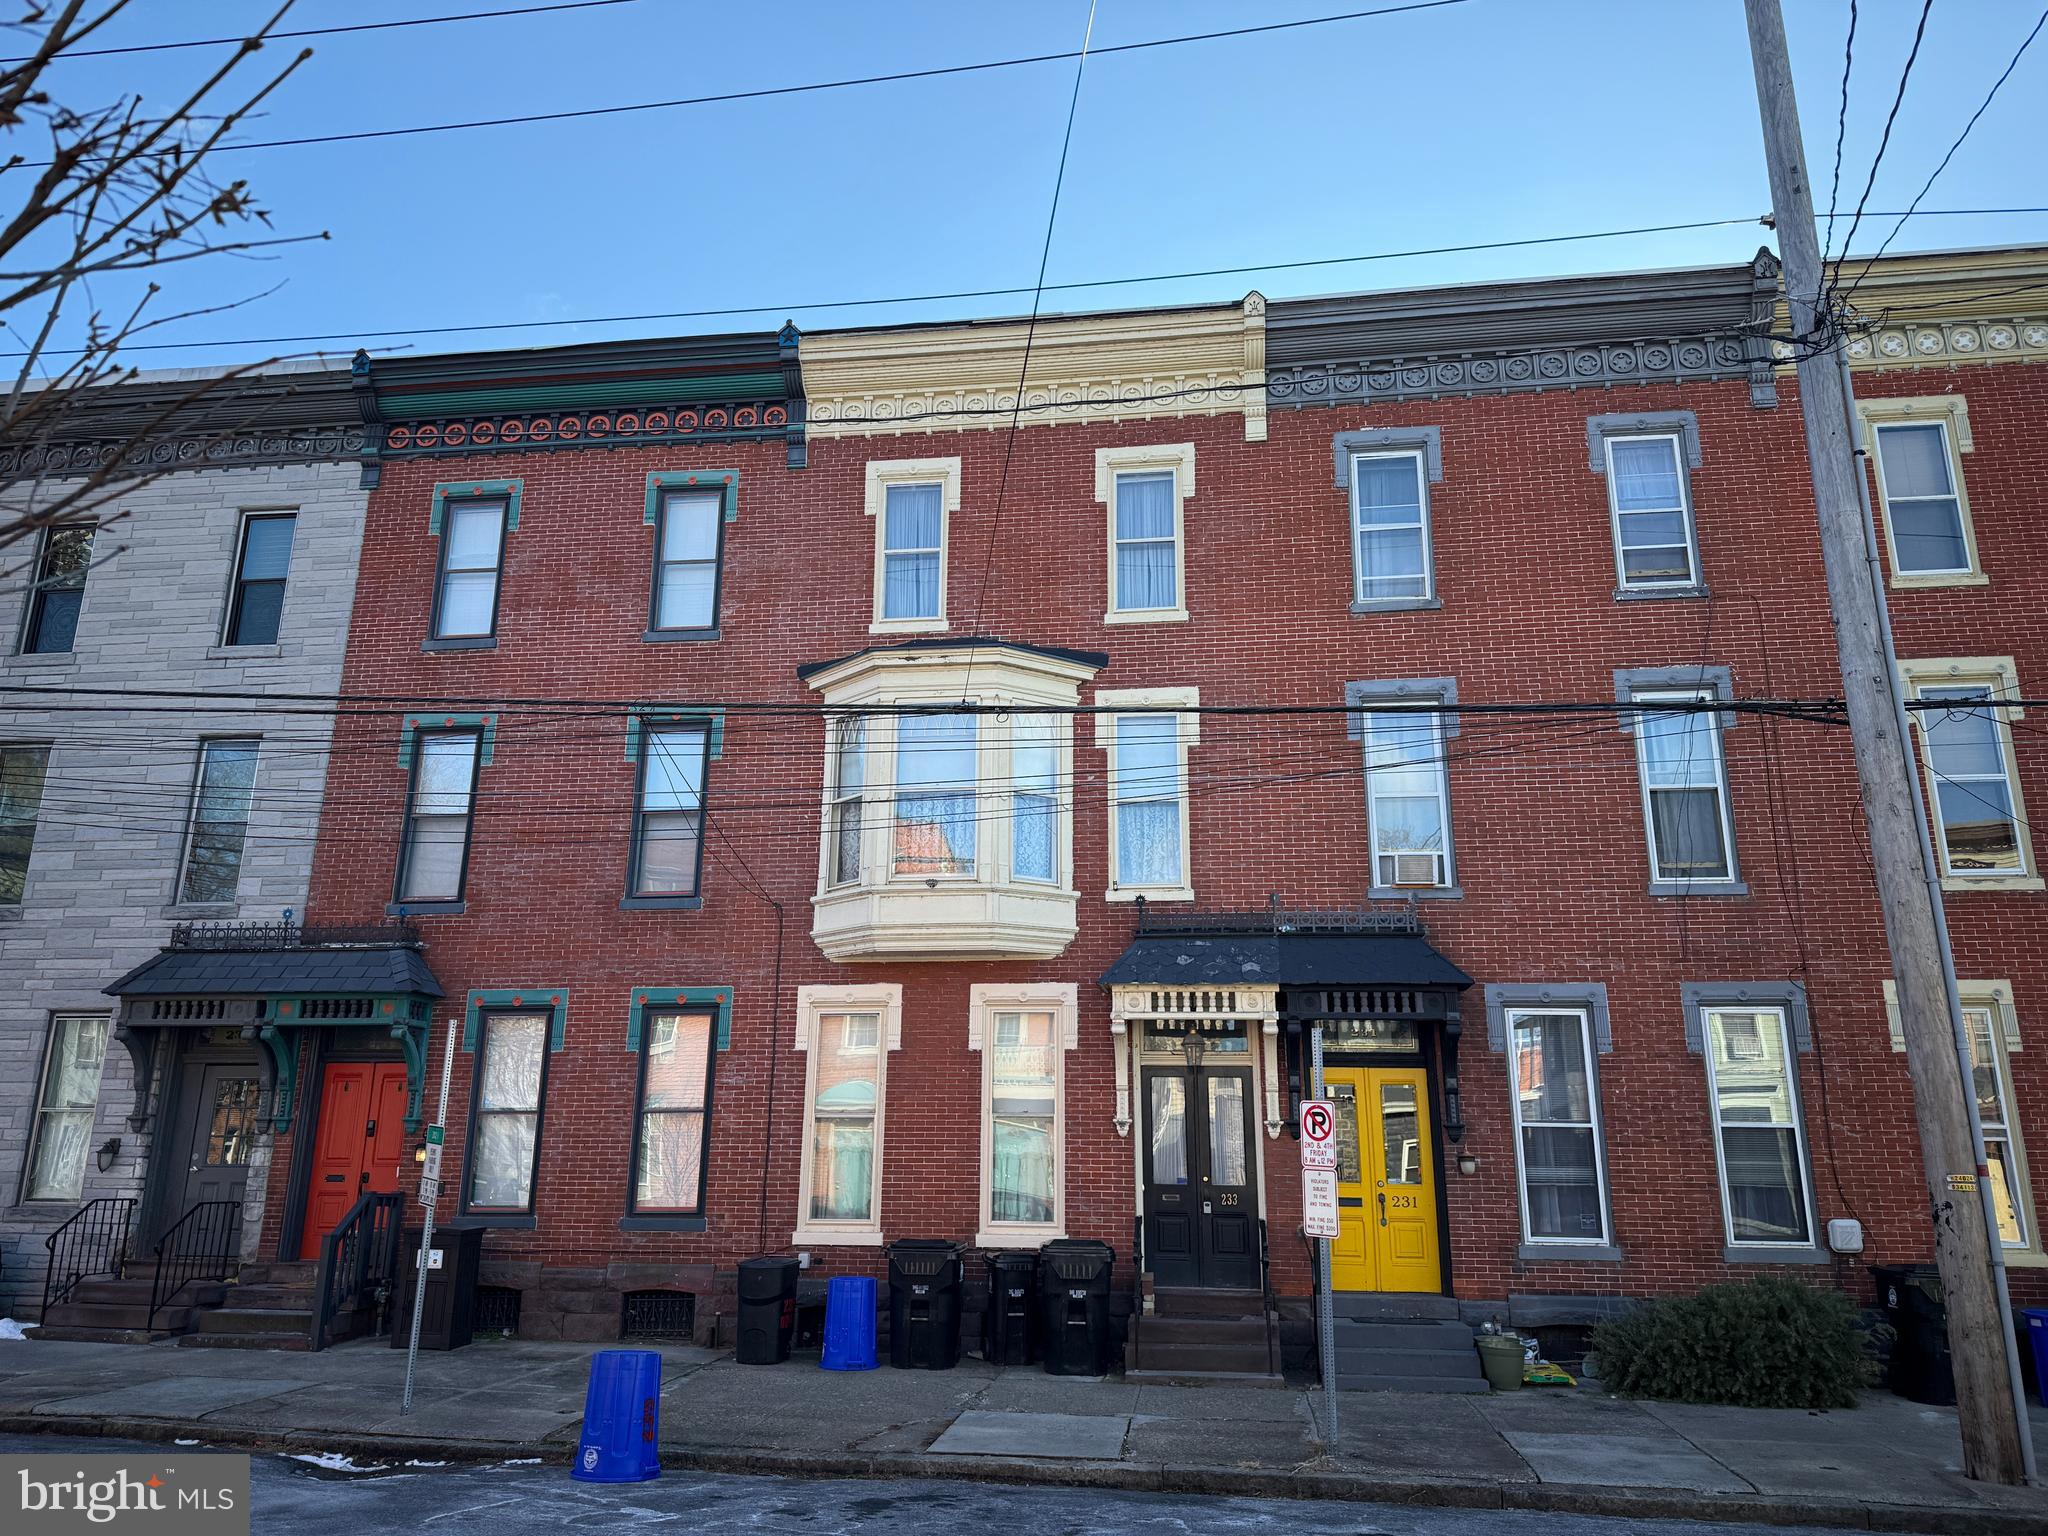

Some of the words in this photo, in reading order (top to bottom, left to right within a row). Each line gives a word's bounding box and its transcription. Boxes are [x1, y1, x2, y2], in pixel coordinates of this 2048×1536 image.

[1351, 1028, 1377, 1037] 231
[1310, 1149, 1327, 1157] FRIDAY
[1327, 1157, 1333, 1165] PM
[1221, 1193, 1238, 1206] 233
[1392, 1195, 1418, 1208] 231
